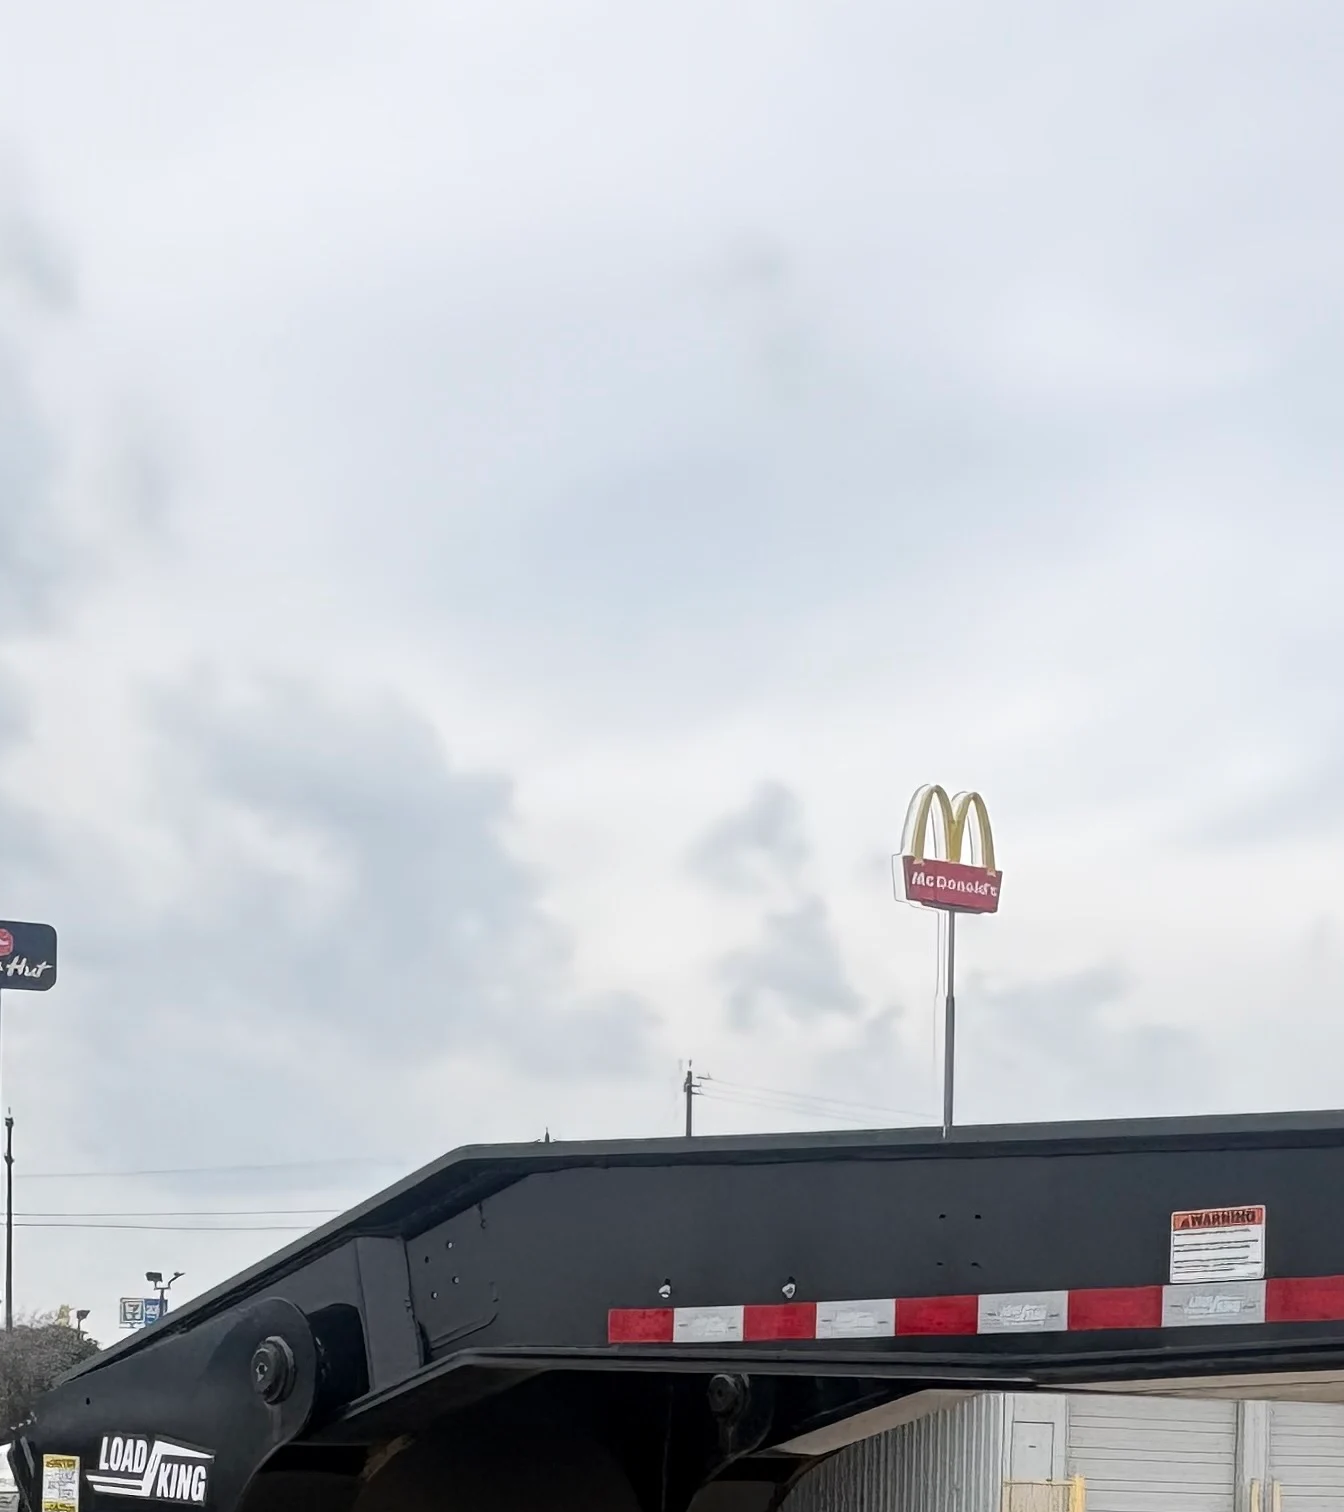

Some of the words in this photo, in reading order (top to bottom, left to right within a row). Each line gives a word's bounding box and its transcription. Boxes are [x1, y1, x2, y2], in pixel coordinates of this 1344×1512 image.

[7, 955, 54, 978] Hut
[98, 1436, 148, 1473] LOAD
[156, 1462, 207, 1501] KING
